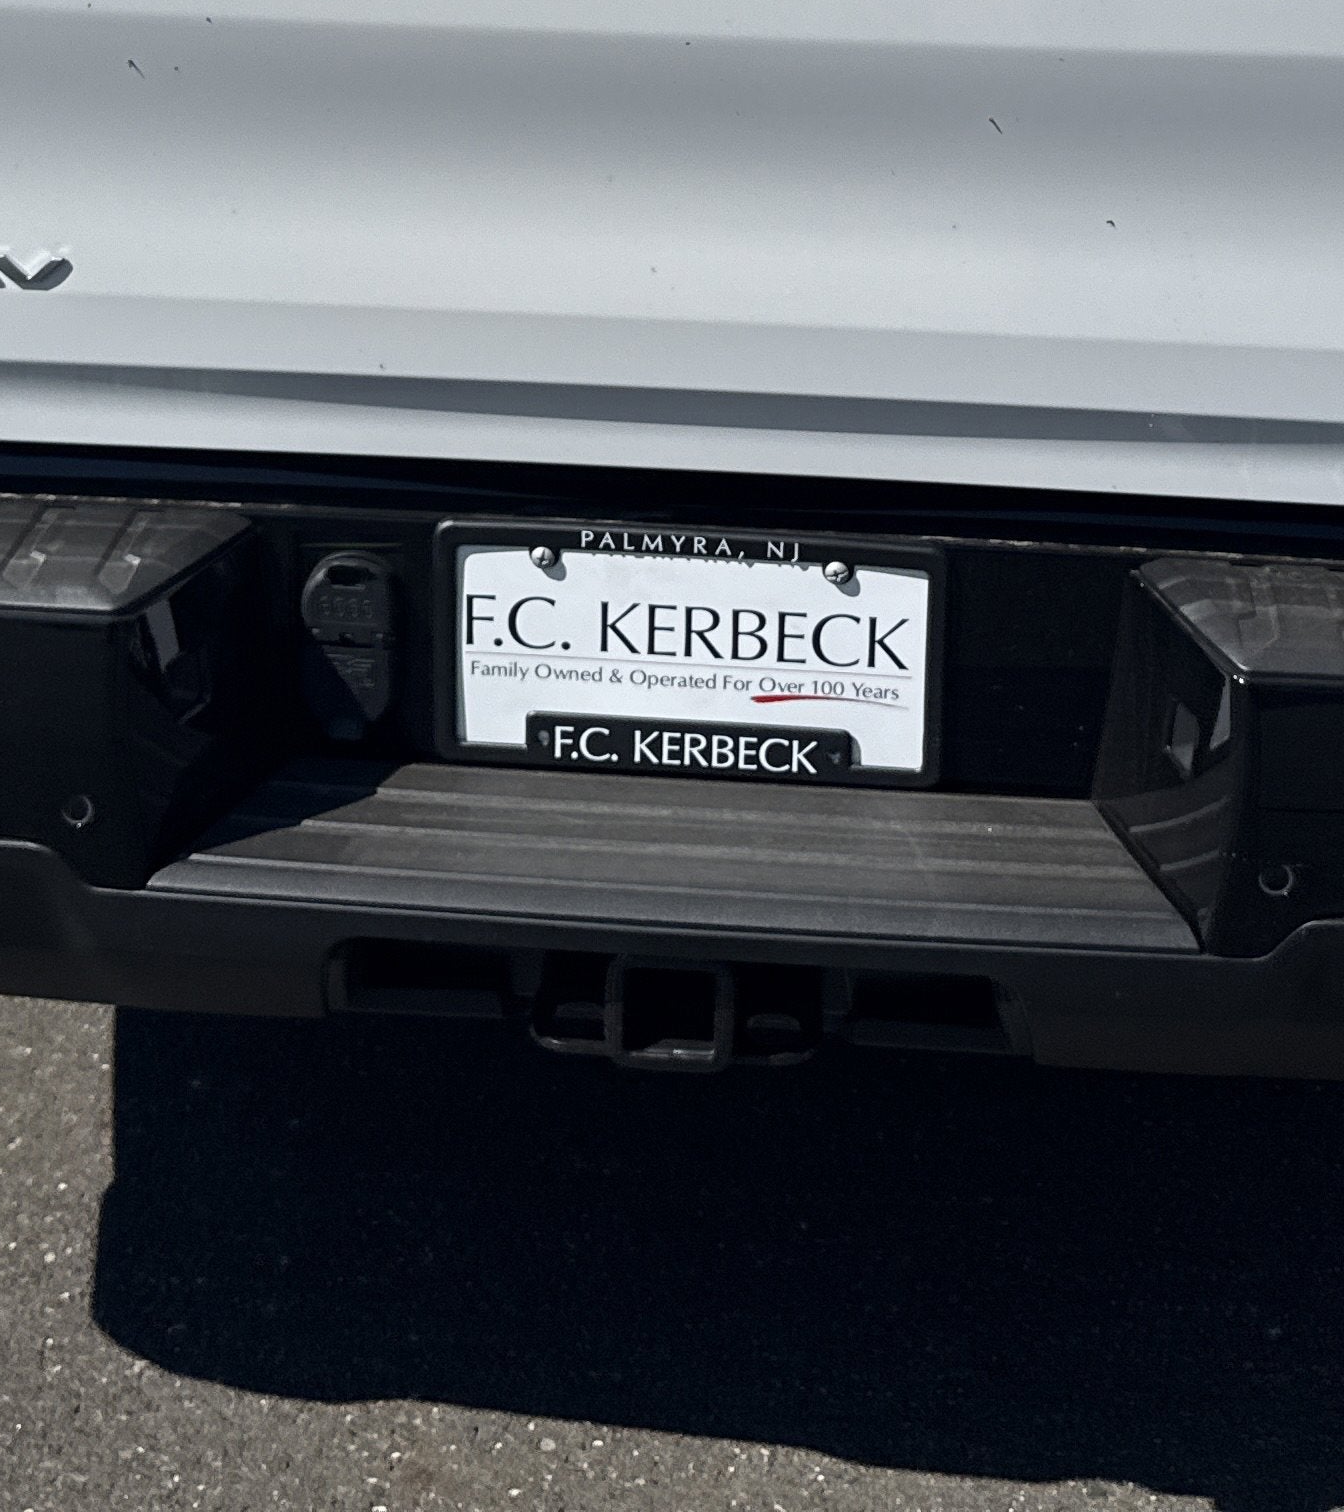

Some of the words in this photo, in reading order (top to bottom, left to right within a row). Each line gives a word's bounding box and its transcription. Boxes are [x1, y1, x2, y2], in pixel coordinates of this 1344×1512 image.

[580, 529, 745, 560] PALMYRA,
[766, 540, 800, 562] NJ
[465, 593, 571, 650] F.C.
[600, 600, 910, 671] KERBECK
[471, 659, 529, 682] Family
[534, 662, 603, 683] Owned
[609, 668, 623, 684] &
[629, 668, 717, 689] Operated
[723, 674, 752, 691] For
[759, 676, 804, 694] Over
[811, 679, 845, 696] 100
[852, 682, 900, 700] Years
[553, 725, 619, 763] F.C.
[633, 729, 818, 775] KERBECK
